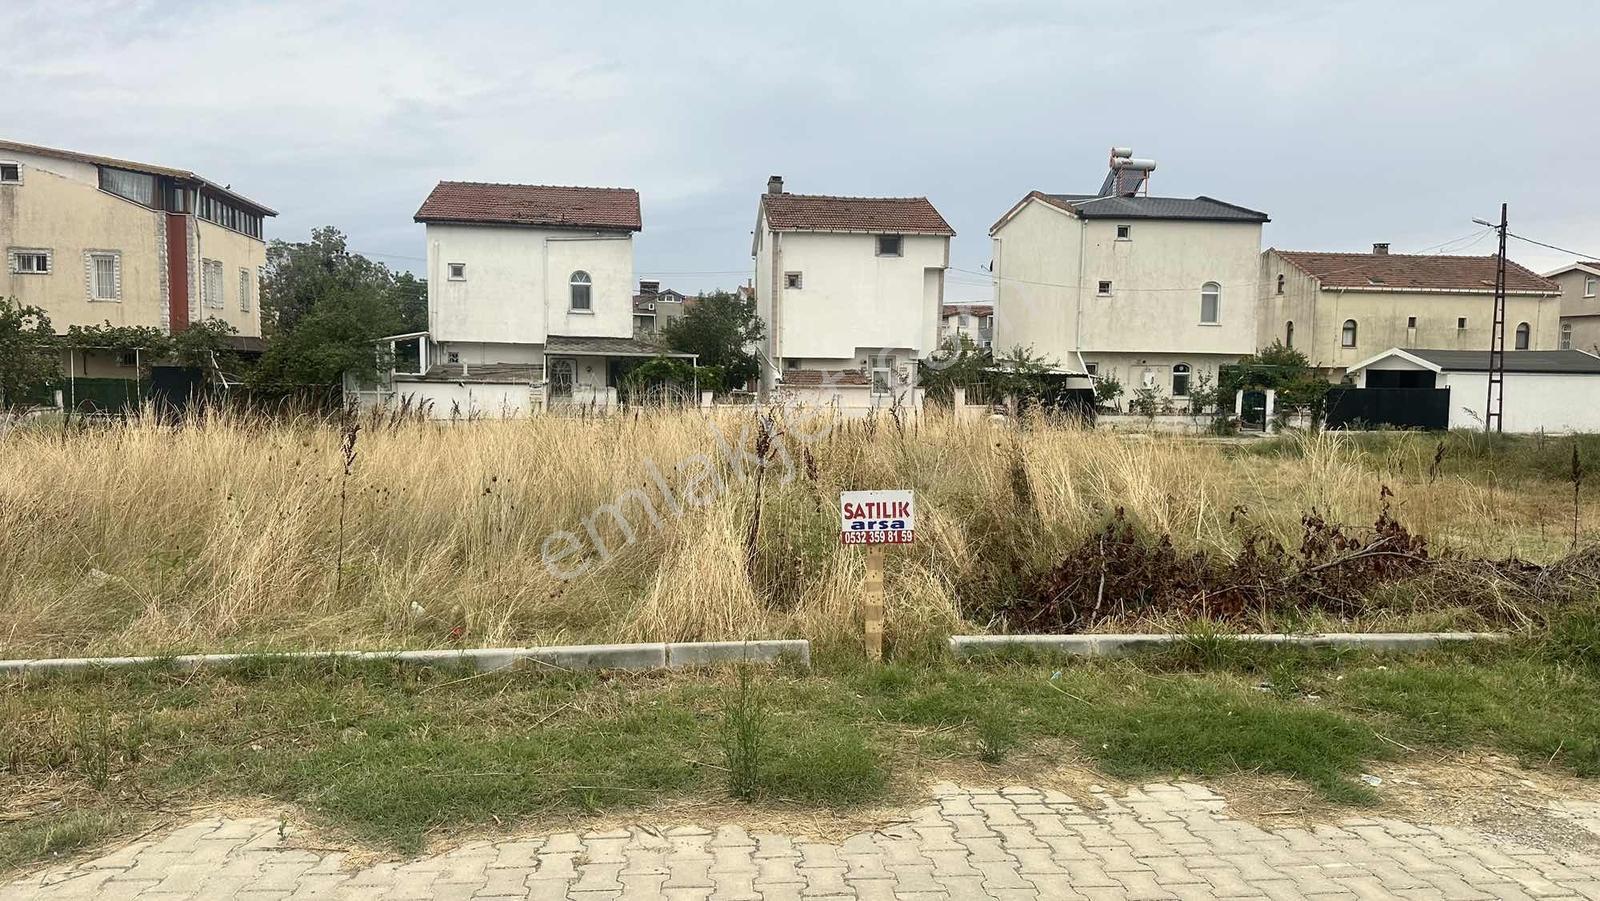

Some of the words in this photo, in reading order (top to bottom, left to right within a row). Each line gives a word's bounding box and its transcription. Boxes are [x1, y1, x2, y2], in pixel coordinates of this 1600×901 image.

[843, 501, 911, 520] SATILIK
[850, 520, 905, 530] arsa
[844, 531, 867, 544] 0532
[869, 531, 886, 543] 359
[887, 530, 898, 542] 81
[901, 530, 913, 542] 59
